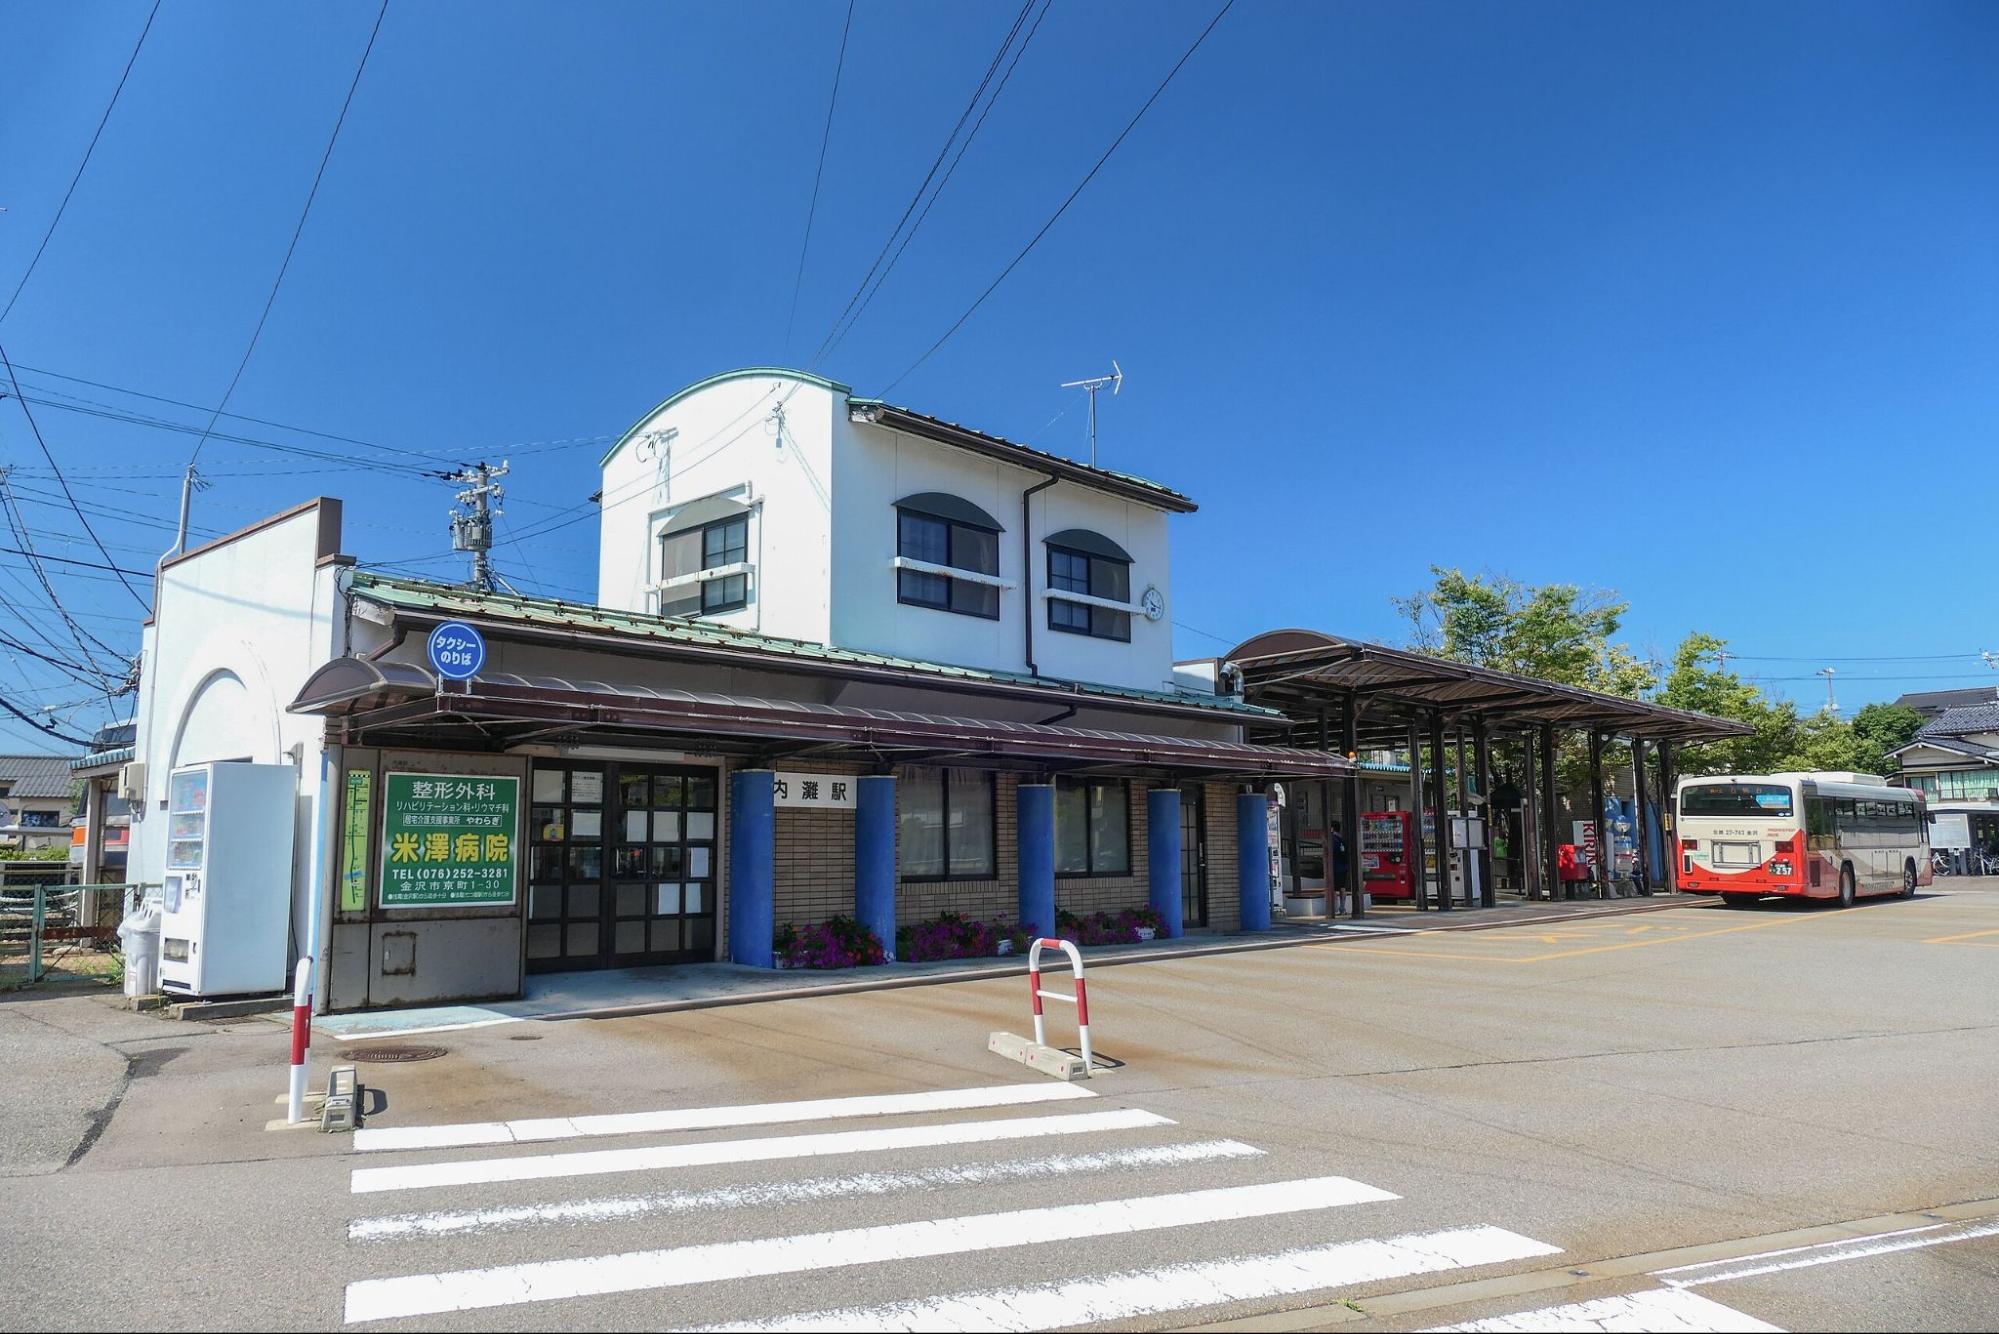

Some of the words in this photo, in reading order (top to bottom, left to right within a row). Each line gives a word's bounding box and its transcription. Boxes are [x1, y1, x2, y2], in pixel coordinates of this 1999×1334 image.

[436, 635, 476, 651] タクシー
[440, 651, 472, 665] のりば
[412, 781, 496, 800] 整形外科
[773, 779, 847, 801] 内灘駅
[466, 816, 501, 826] やわらぎ
[392, 832, 509, 863] 米澤病院
[1583, 823, 1598, 865] KIRIN
